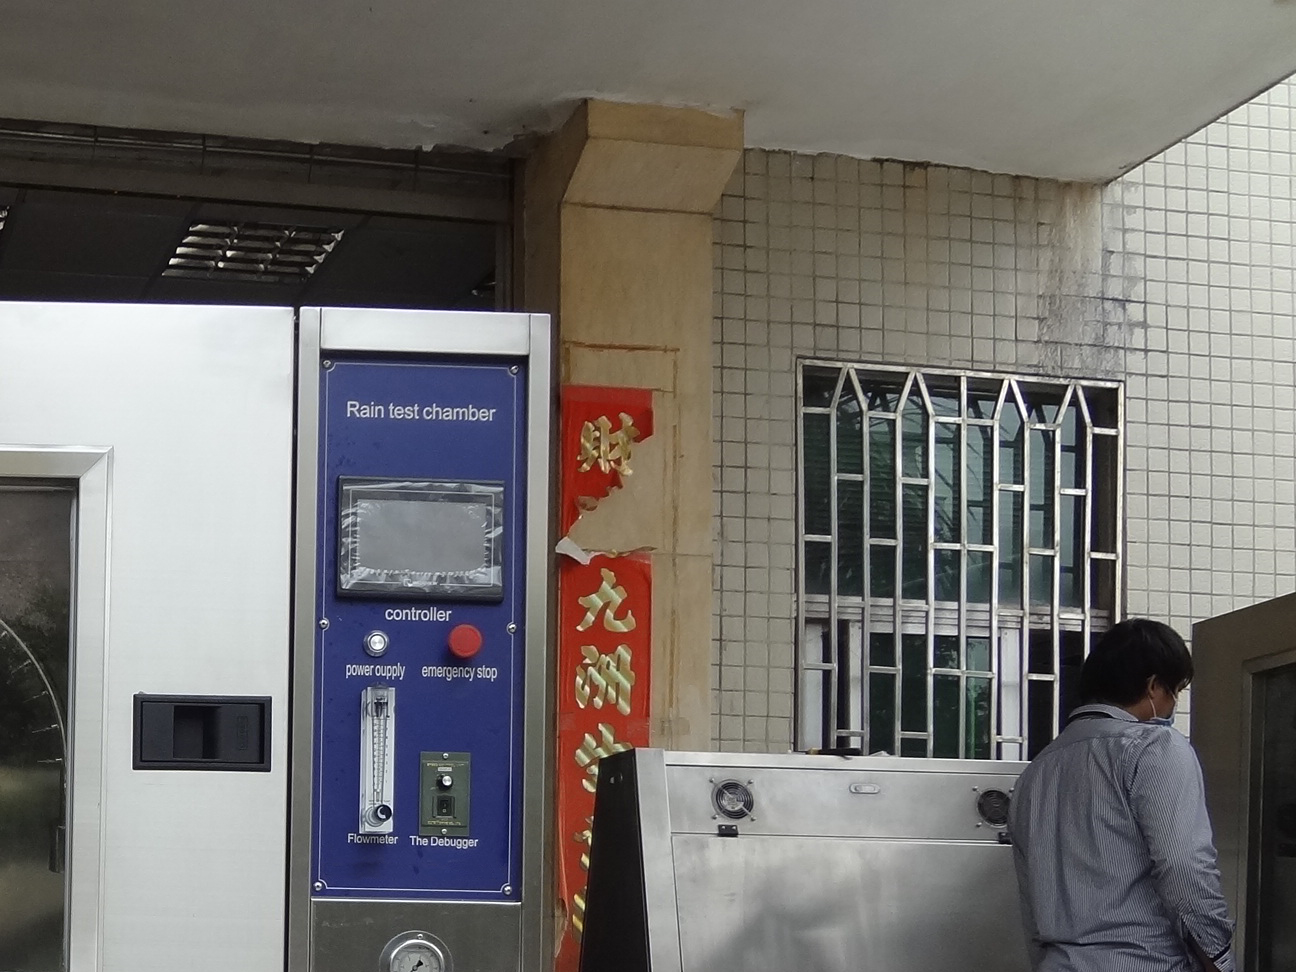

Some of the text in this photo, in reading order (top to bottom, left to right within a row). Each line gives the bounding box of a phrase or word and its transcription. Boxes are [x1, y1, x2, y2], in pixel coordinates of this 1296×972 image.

[346, 401, 497, 422] Rain test chamber
[385, 607, 452, 622] controller
[345, 664, 375, 679] power
[421, 664, 498, 682] emergency stop
[347, 833, 399, 845] Flowmeter
[409, 835, 479, 849] The Debugger
